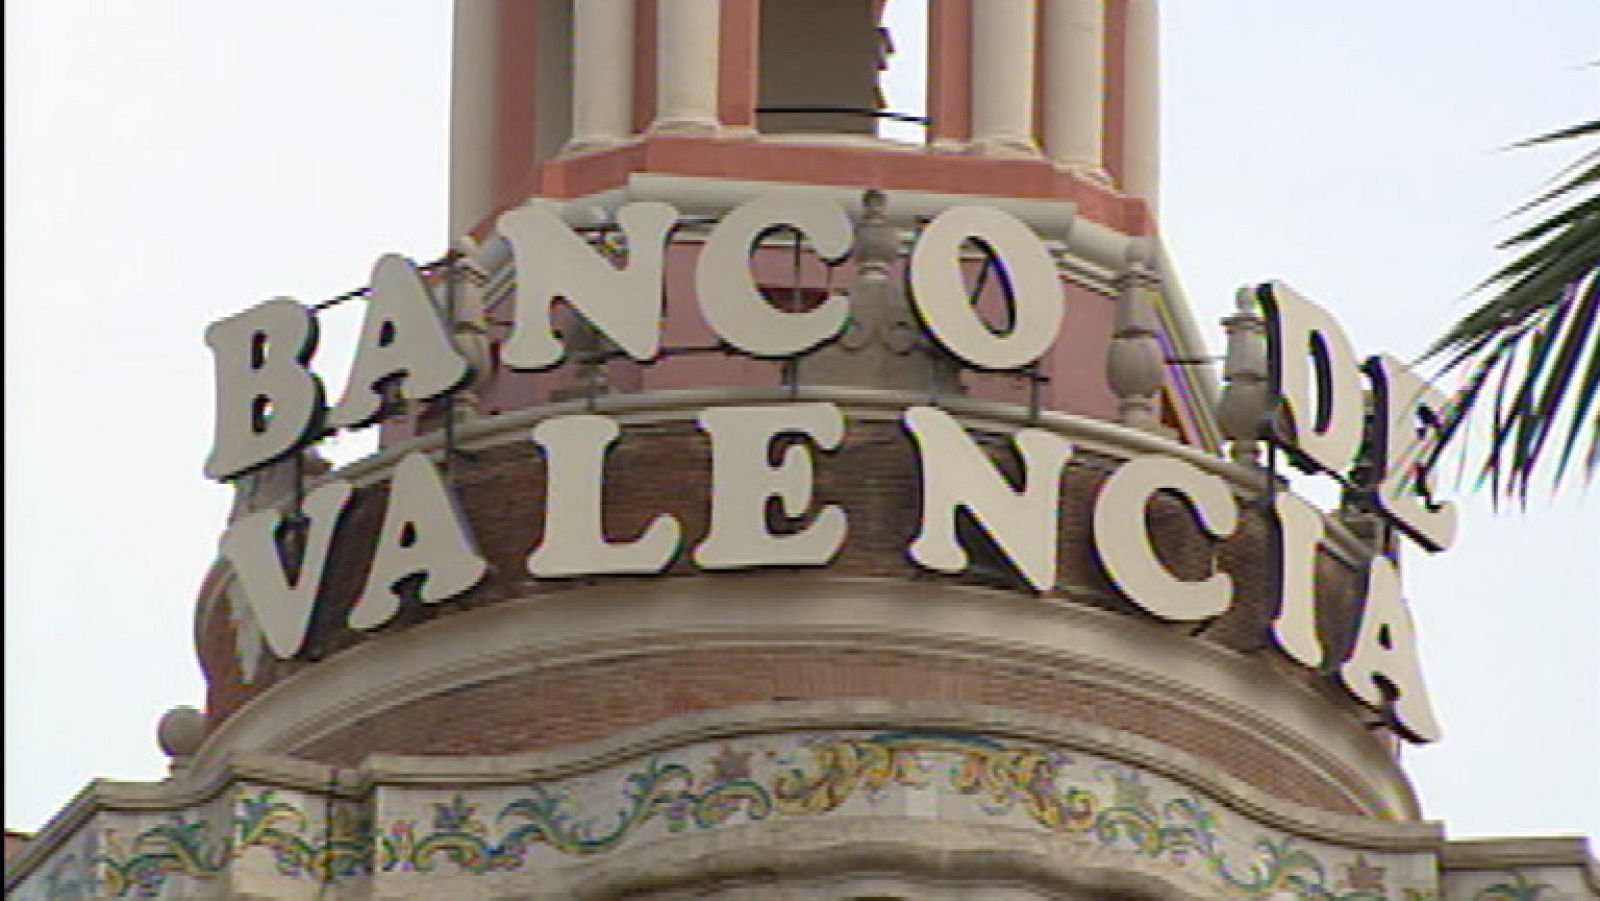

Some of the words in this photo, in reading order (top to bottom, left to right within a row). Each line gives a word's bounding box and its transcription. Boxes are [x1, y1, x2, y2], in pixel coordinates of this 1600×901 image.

[204, 191, 1065, 482] BANCO
[1256, 280, 1459, 552] DE
[220, 402, 1441, 743] VALENCIA
